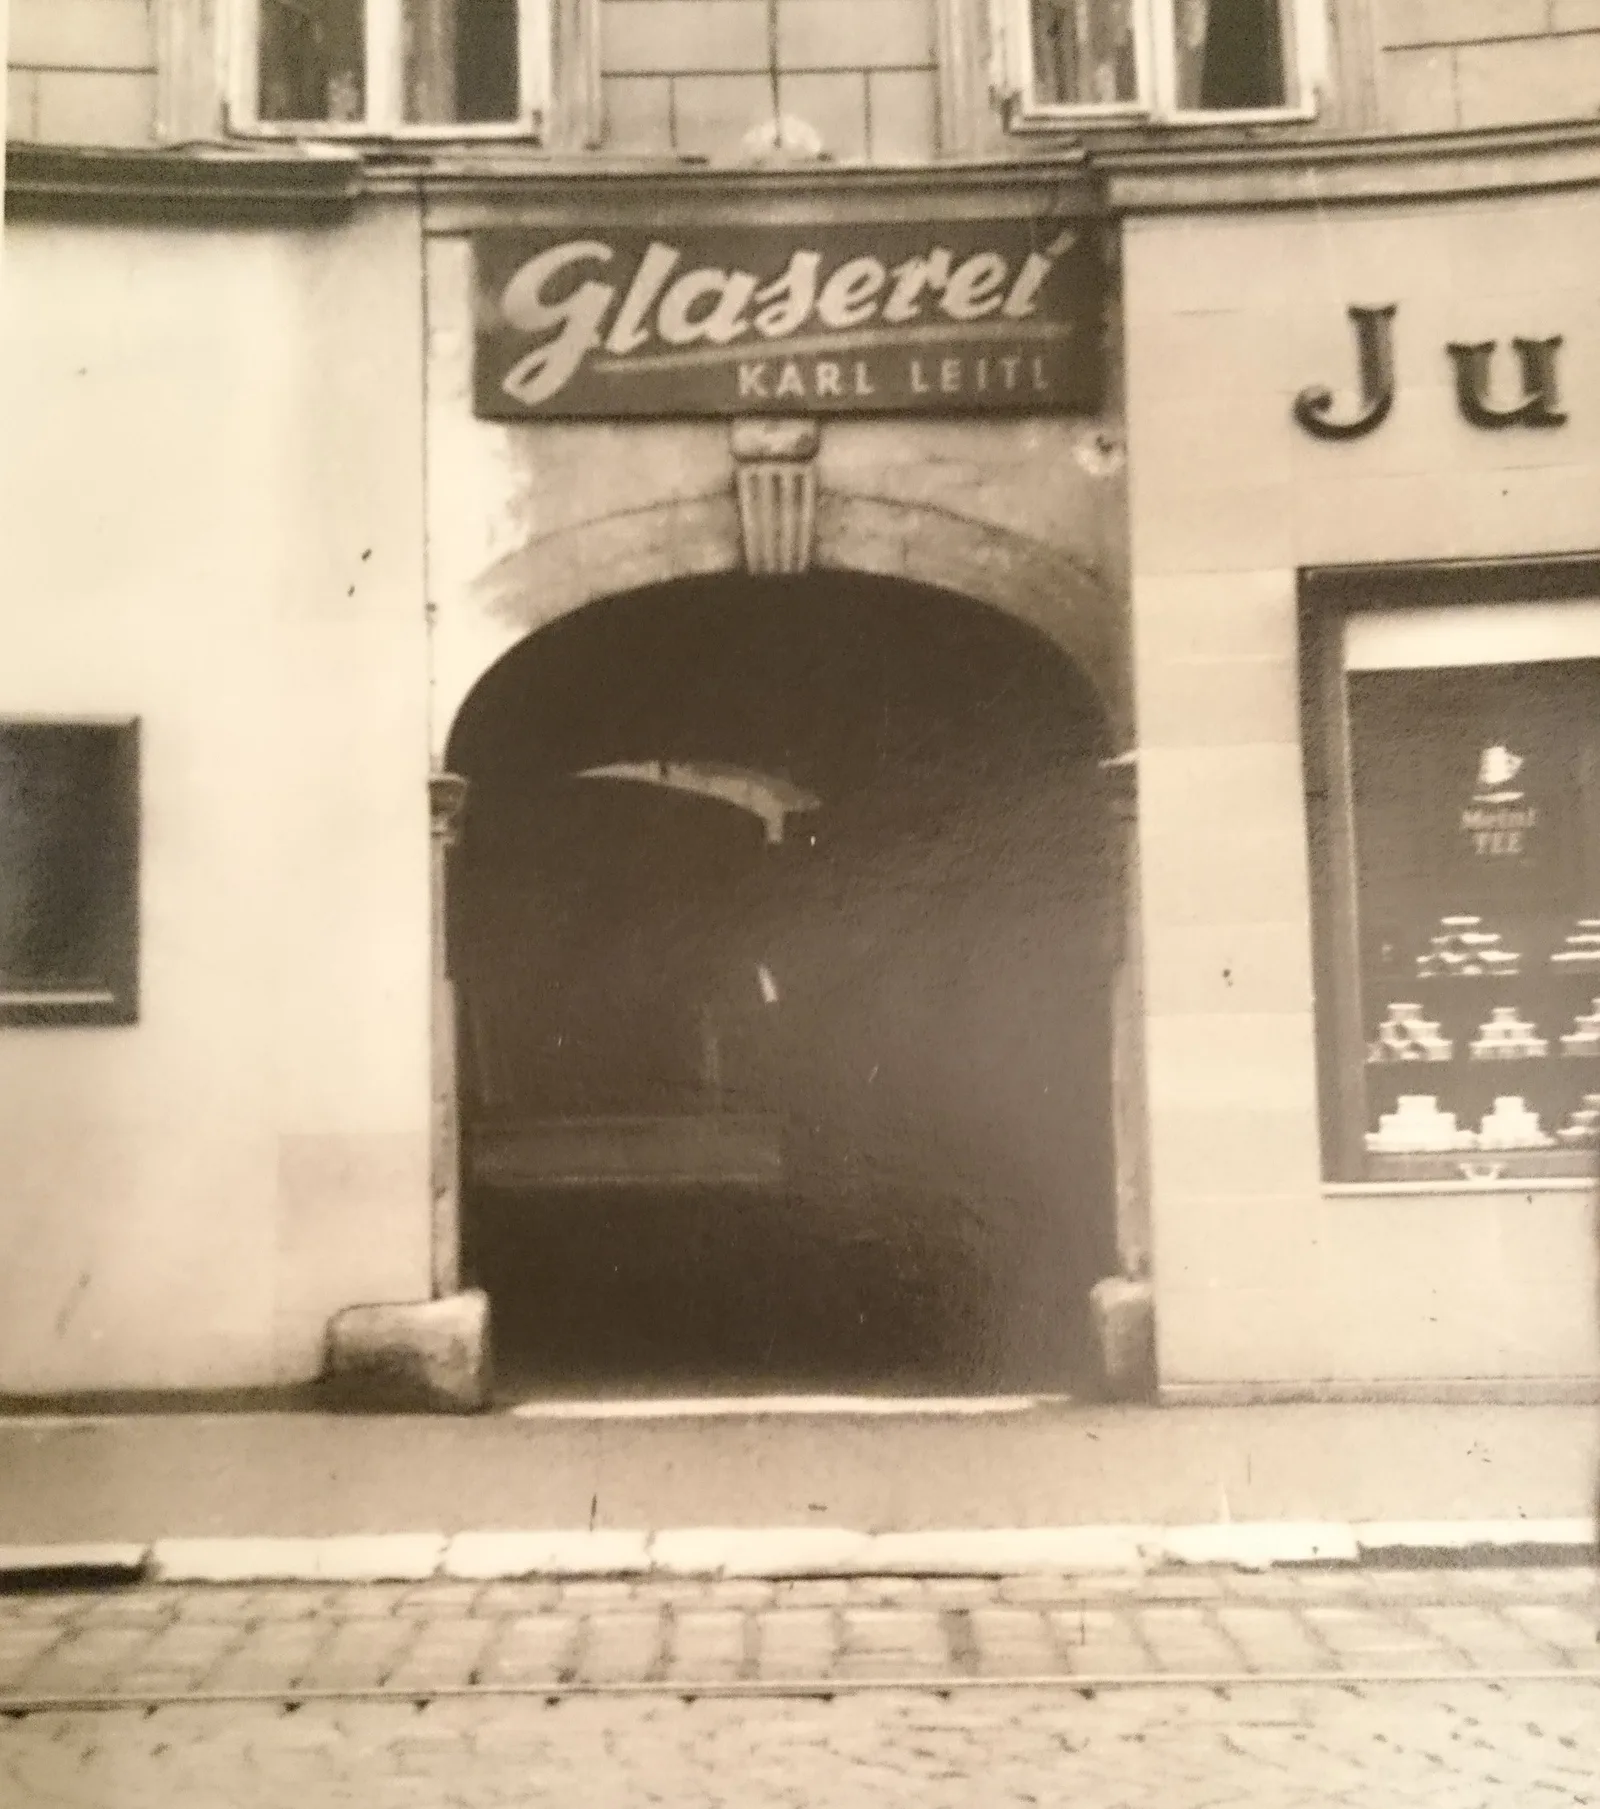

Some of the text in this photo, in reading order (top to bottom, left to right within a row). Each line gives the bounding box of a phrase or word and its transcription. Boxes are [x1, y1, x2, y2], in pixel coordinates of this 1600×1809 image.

[502, 231, 1077, 406] Glaserei
[737, 356, 1050, 398] KARL LEITL
[1292, 302, 1569, 441] Ju
